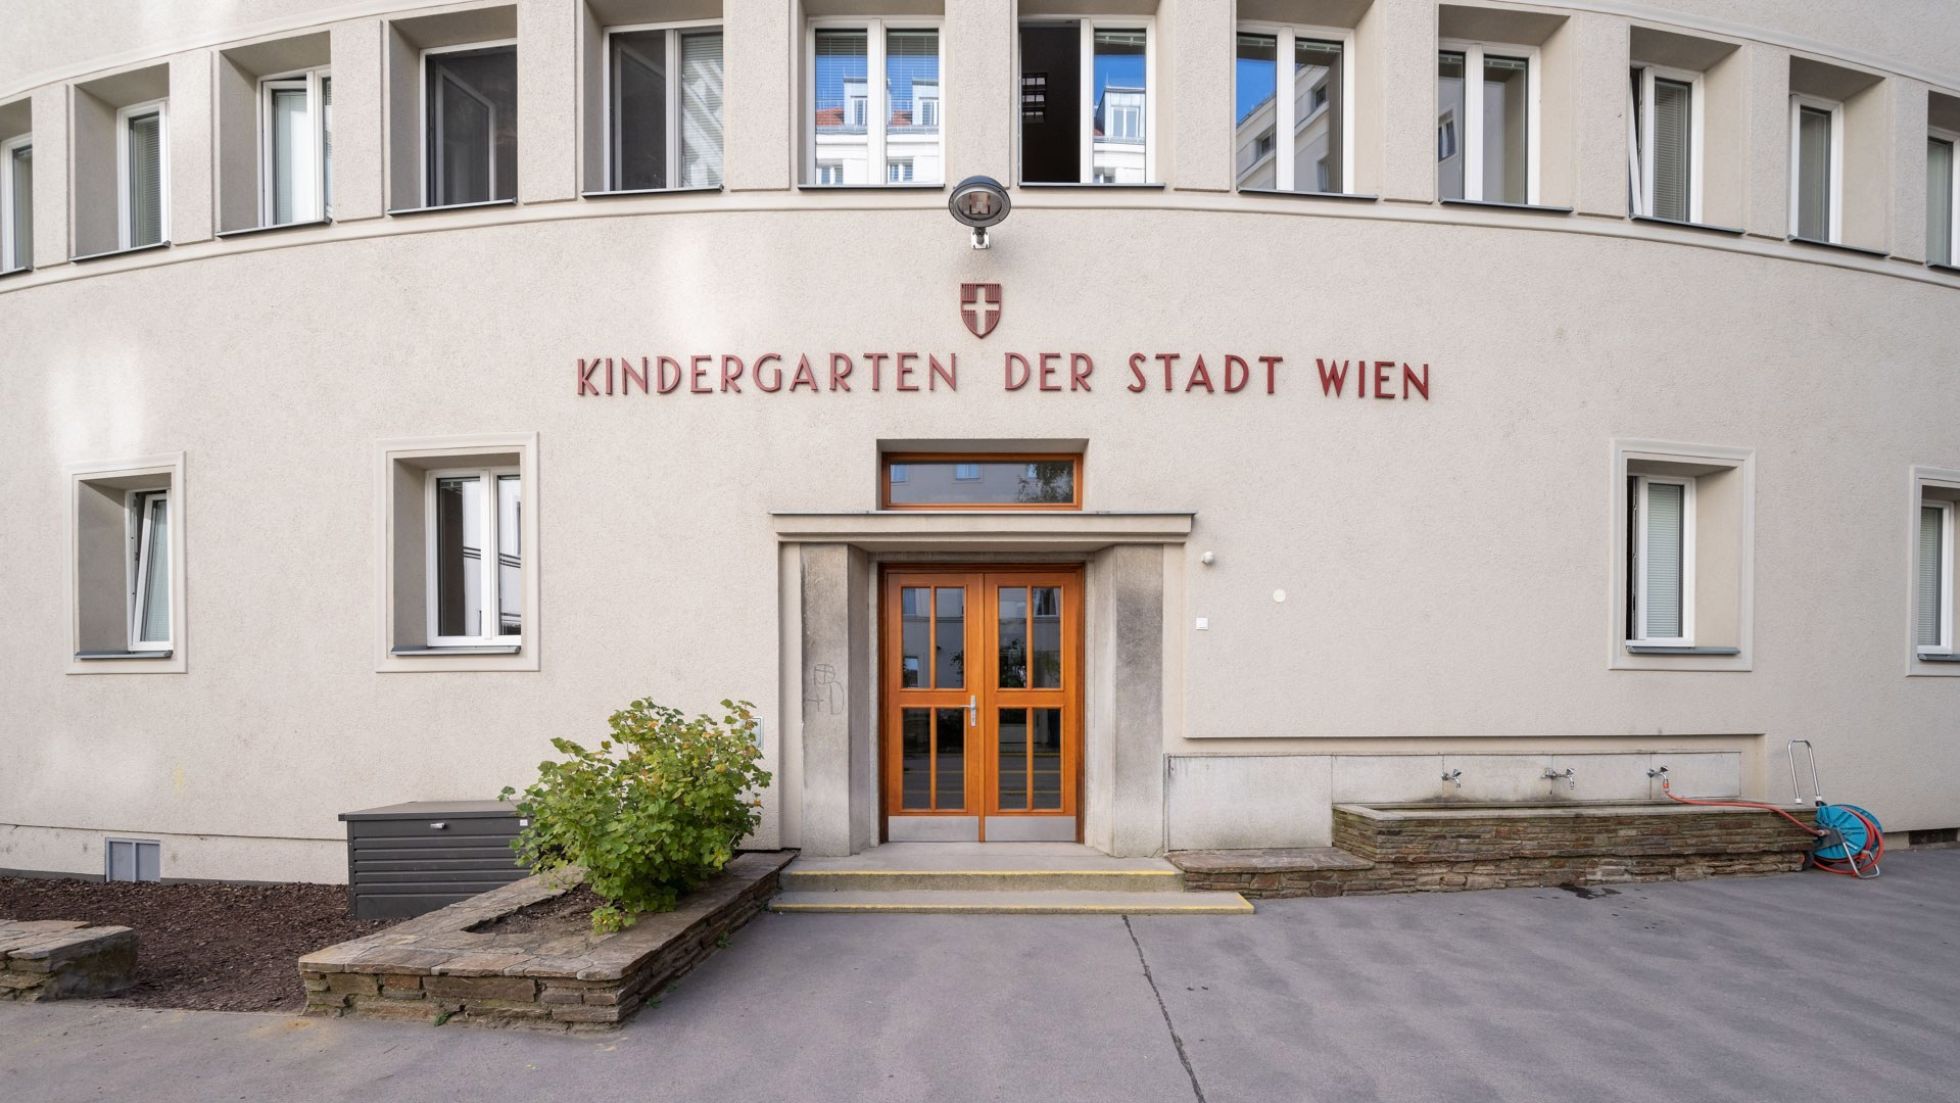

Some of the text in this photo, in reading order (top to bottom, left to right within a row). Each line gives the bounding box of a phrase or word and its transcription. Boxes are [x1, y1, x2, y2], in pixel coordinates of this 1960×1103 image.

[577, 352, 1429, 400] KINDERGARTEN DER STADT WIEN
